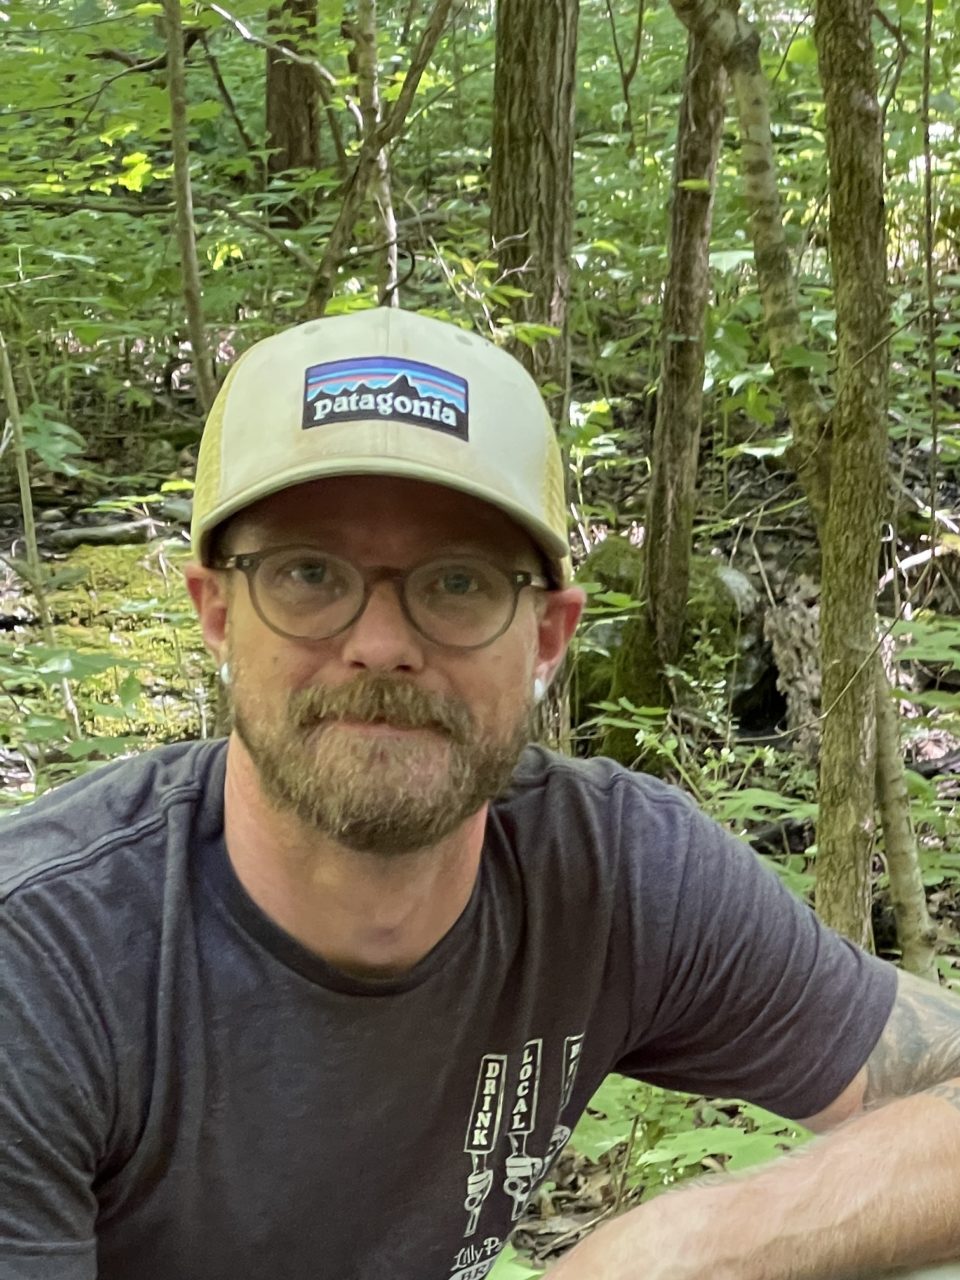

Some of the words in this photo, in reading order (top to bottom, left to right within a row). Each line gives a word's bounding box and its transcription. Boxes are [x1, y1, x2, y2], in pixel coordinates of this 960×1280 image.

[313, 391, 457, 426] patagonia
[472, 1062, 500, 1146] DRINK
[511, 1048, 533, 1130] LOCAL
[450, 1244, 484, 1271] Lilly
